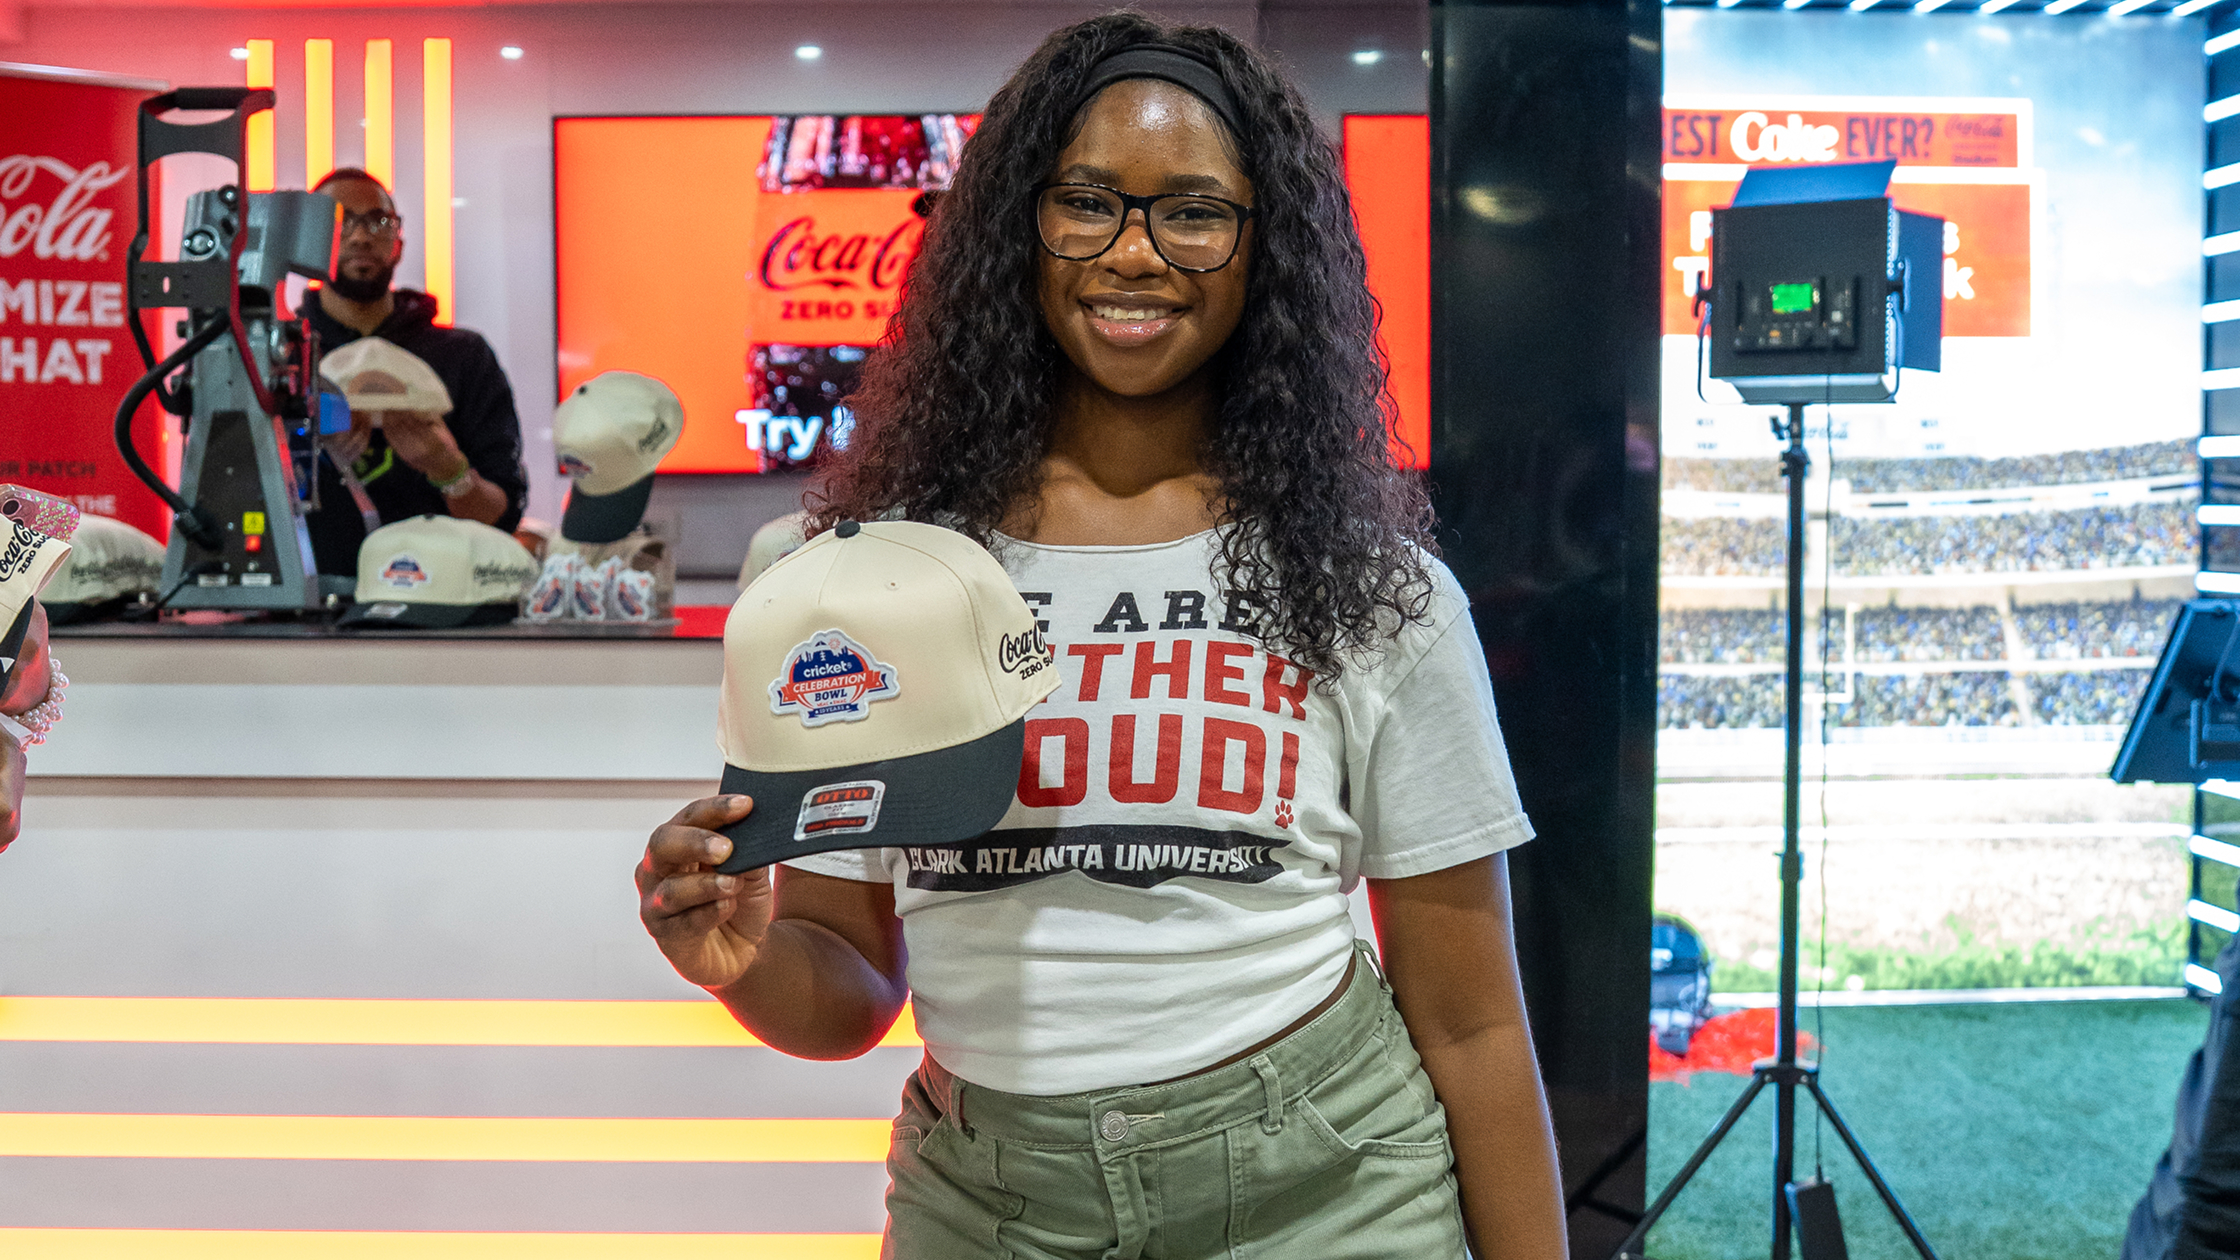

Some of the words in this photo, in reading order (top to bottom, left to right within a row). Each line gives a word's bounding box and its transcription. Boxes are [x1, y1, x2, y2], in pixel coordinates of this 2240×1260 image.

[1662, 114, 1722, 157] EST
[1730, 111, 1840, 162] Coke
[1846, 117, 1934, 158] EVER?
[0, 154, 131, 262] ola
[761, 216, 926, 290] Coca-C
[0, 278, 124, 327] MIZE
[781, 300, 854, 320] ZERO
[0, 336, 112, 385] HAT
[735, 408, 824, 461] Try
[17, 550, 37, 574] ZERO
[1019, 592, 1052, 633] E
[1093, 588, 1262, 635] ARE
[793, 672, 867, 693] CELEBRATION
[803, 660, 848, 678] cricket
[1019, 661, 1043, 681] ZERO
[1040, 639, 1316, 722] THER
[814, 688, 848, 702] BOWL
[1016, 713, 1300, 815] OUD!
[816, 788, 869, 803] OTTO
[909, 846, 968, 875] CLARK
[976, 844, 1105, 875] ATLANTA
[1114, 844, 1266, 873] UNIVERSITY
